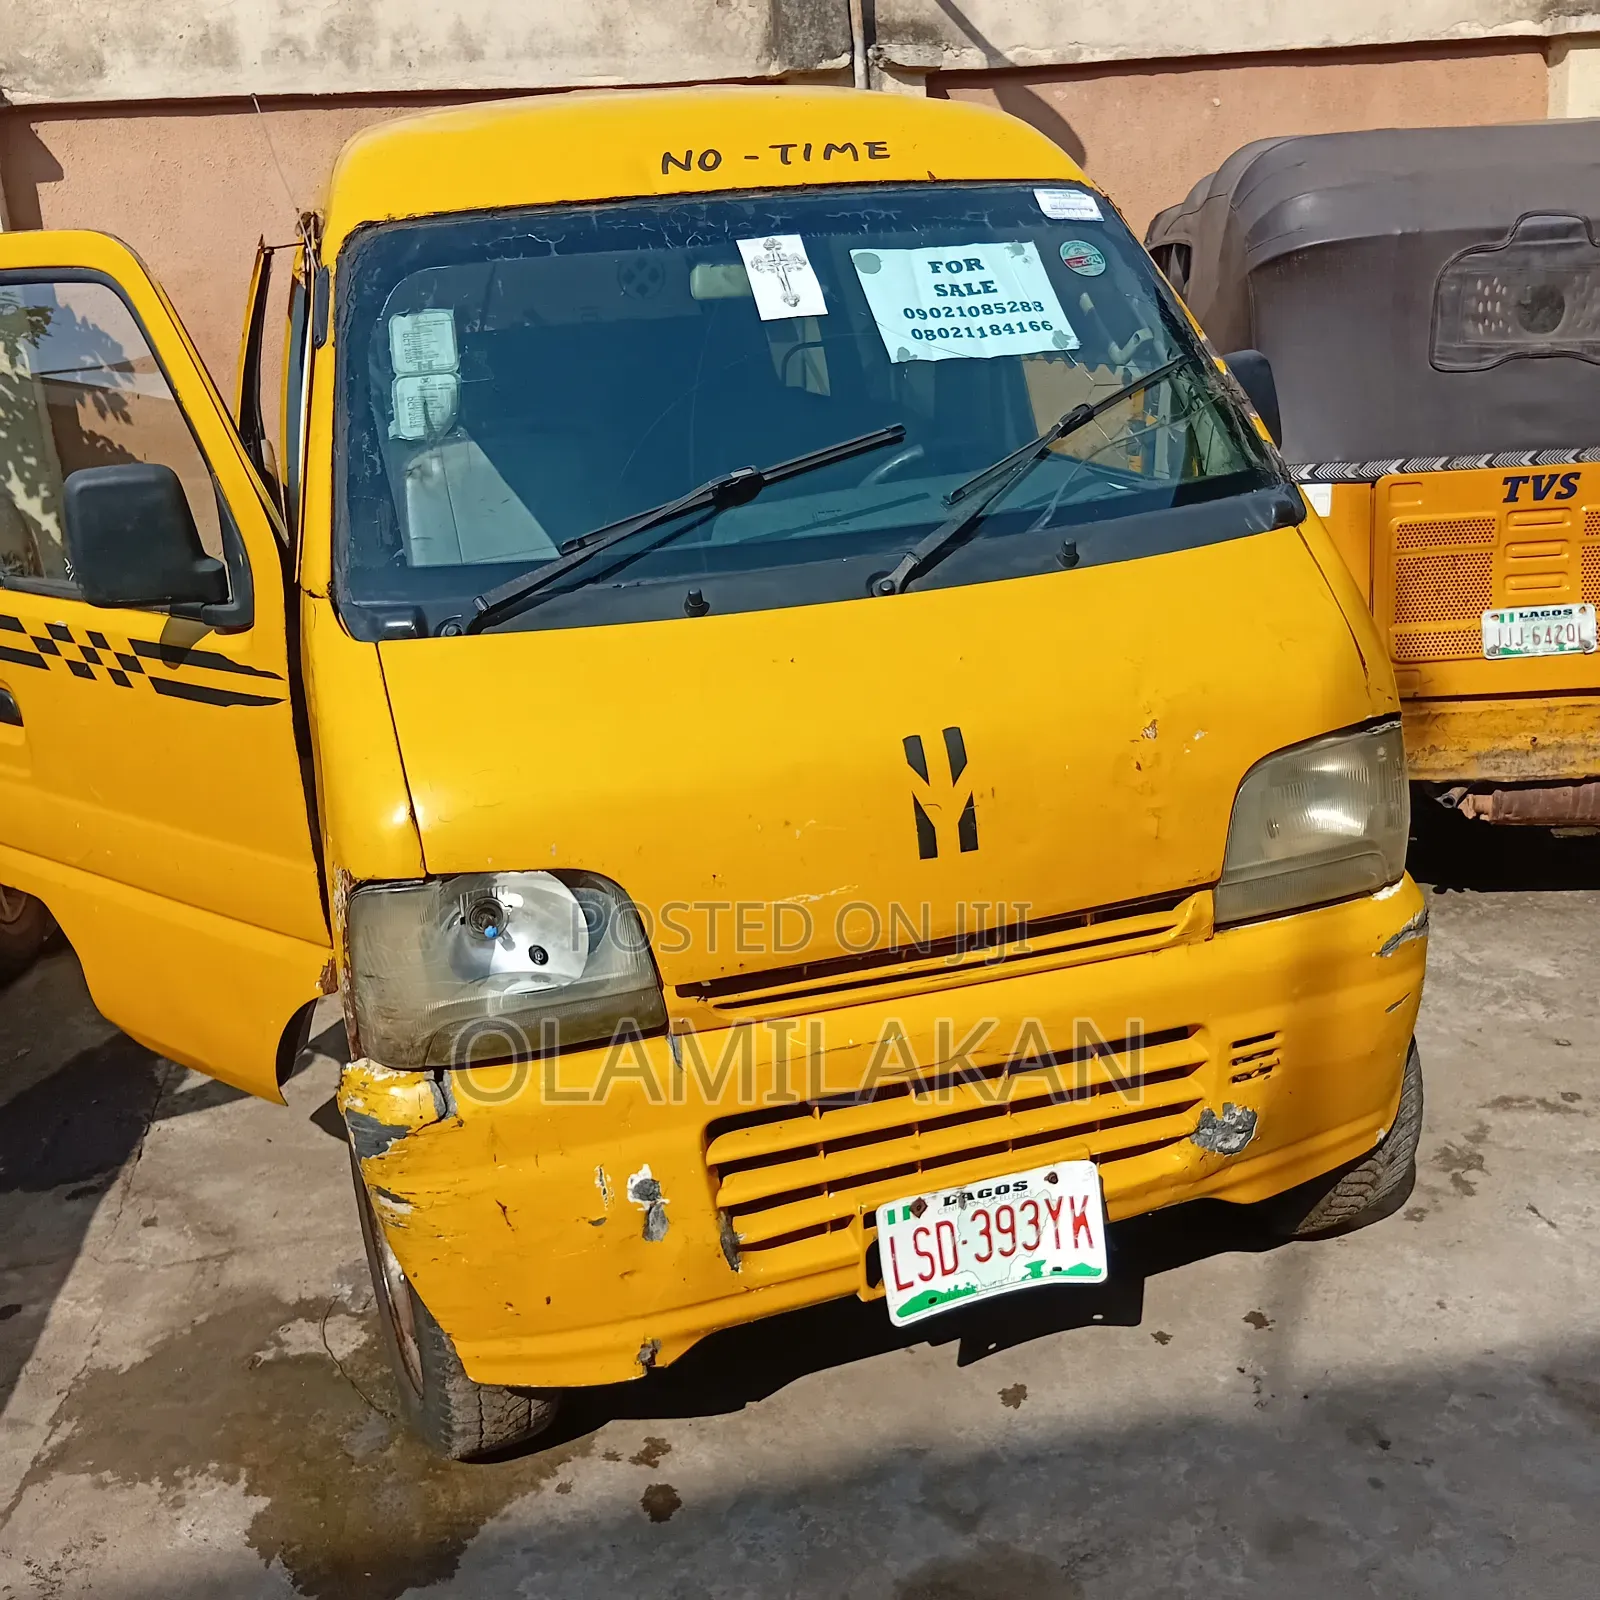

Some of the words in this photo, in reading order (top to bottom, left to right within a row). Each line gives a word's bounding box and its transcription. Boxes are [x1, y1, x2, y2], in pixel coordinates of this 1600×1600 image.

[661, 148, 722, 175] NO
[768, 141, 891, 166] TIME
[927, 257, 985, 274] FOR
[933, 280, 998, 297] SALE
[903, 300, 1045, 321] 09021085288
[911, 320, 1054, 341] 08021184166
[1502, 472, 1582, 503] TVS
[1519, 608, 1573, 619] LAGOS
[943, 1180, 1028, 1207] LAGOS
[889, 1195, 1094, 1292] LSD-393YK
